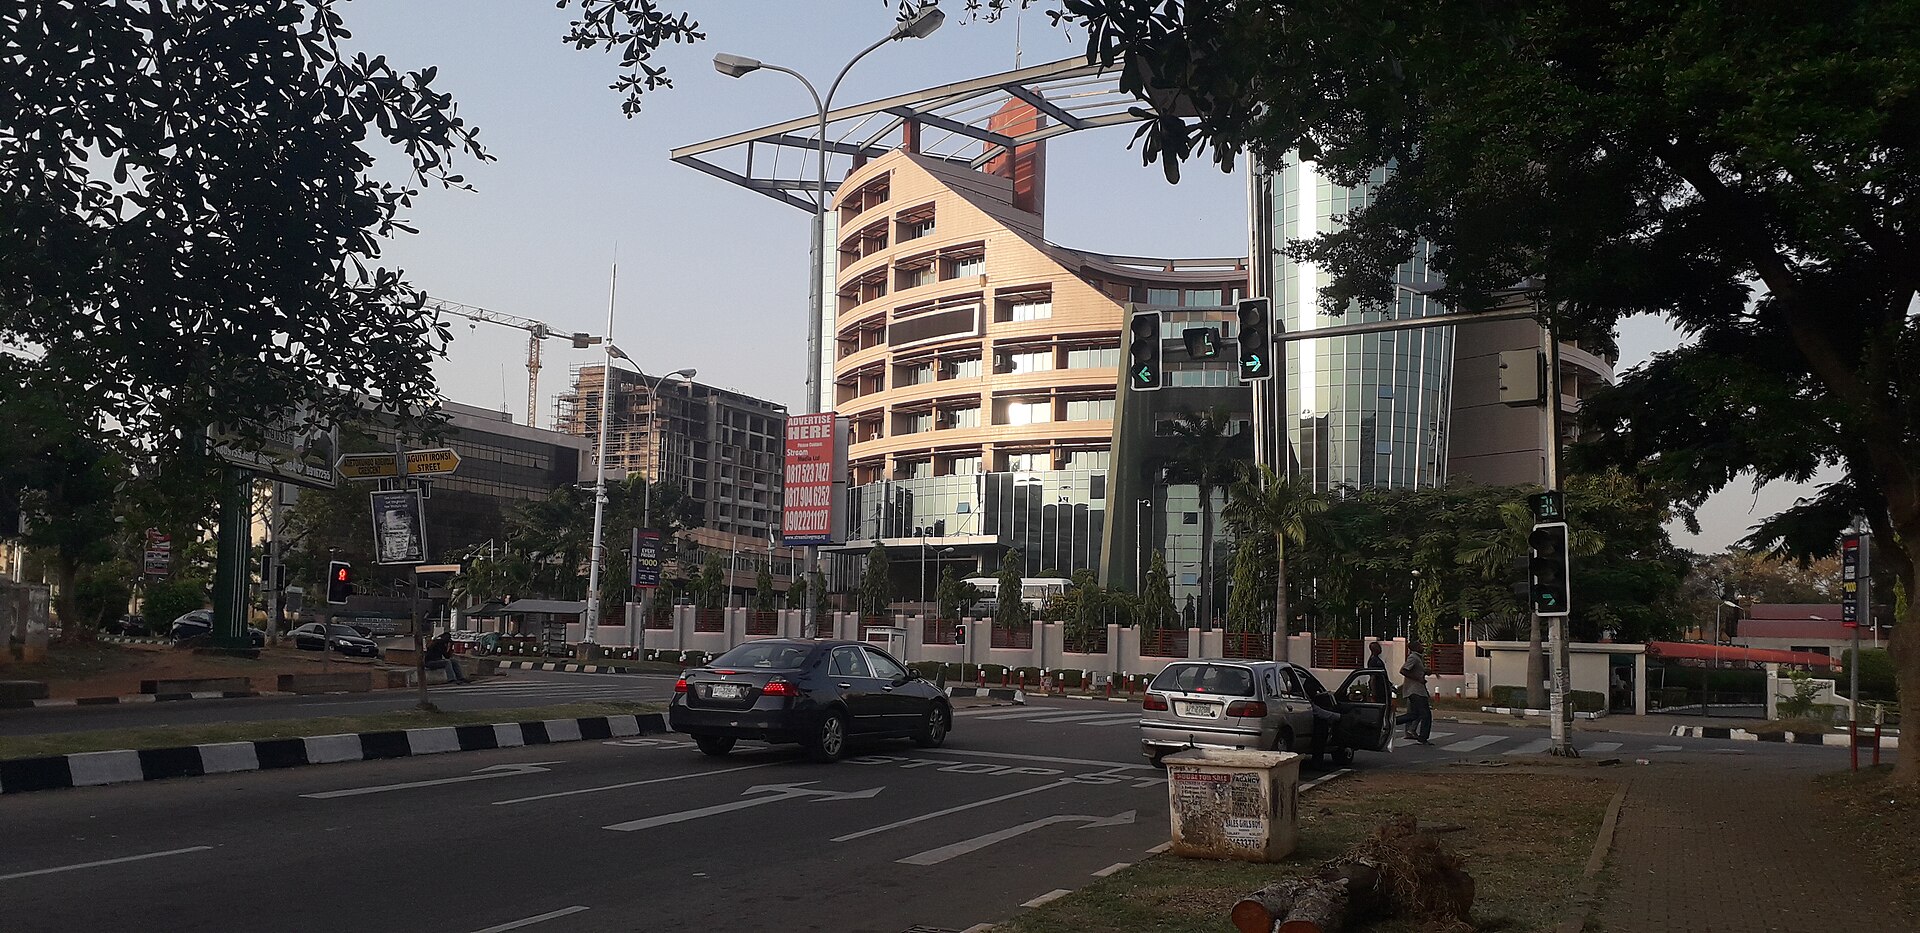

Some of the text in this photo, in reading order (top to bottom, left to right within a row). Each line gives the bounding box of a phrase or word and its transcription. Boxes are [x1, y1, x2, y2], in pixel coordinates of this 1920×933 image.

[787, 415, 832, 427] ADVERTISE
[788, 424, 831, 440] HERE
[407, 452, 451, 463] AGUIYI IRONSI
[787, 448, 809, 456] Stream
[417, 463, 441, 472] STREET
[786, 462, 830, 483] 0817 523 7427
[784, 485, 830, 508] 0817 904 6252
[846, 756, 1064, 775] STOP
[1231, 776, 1260, 784] VACANCY
[1225, 819, 1239, 828] SALES
